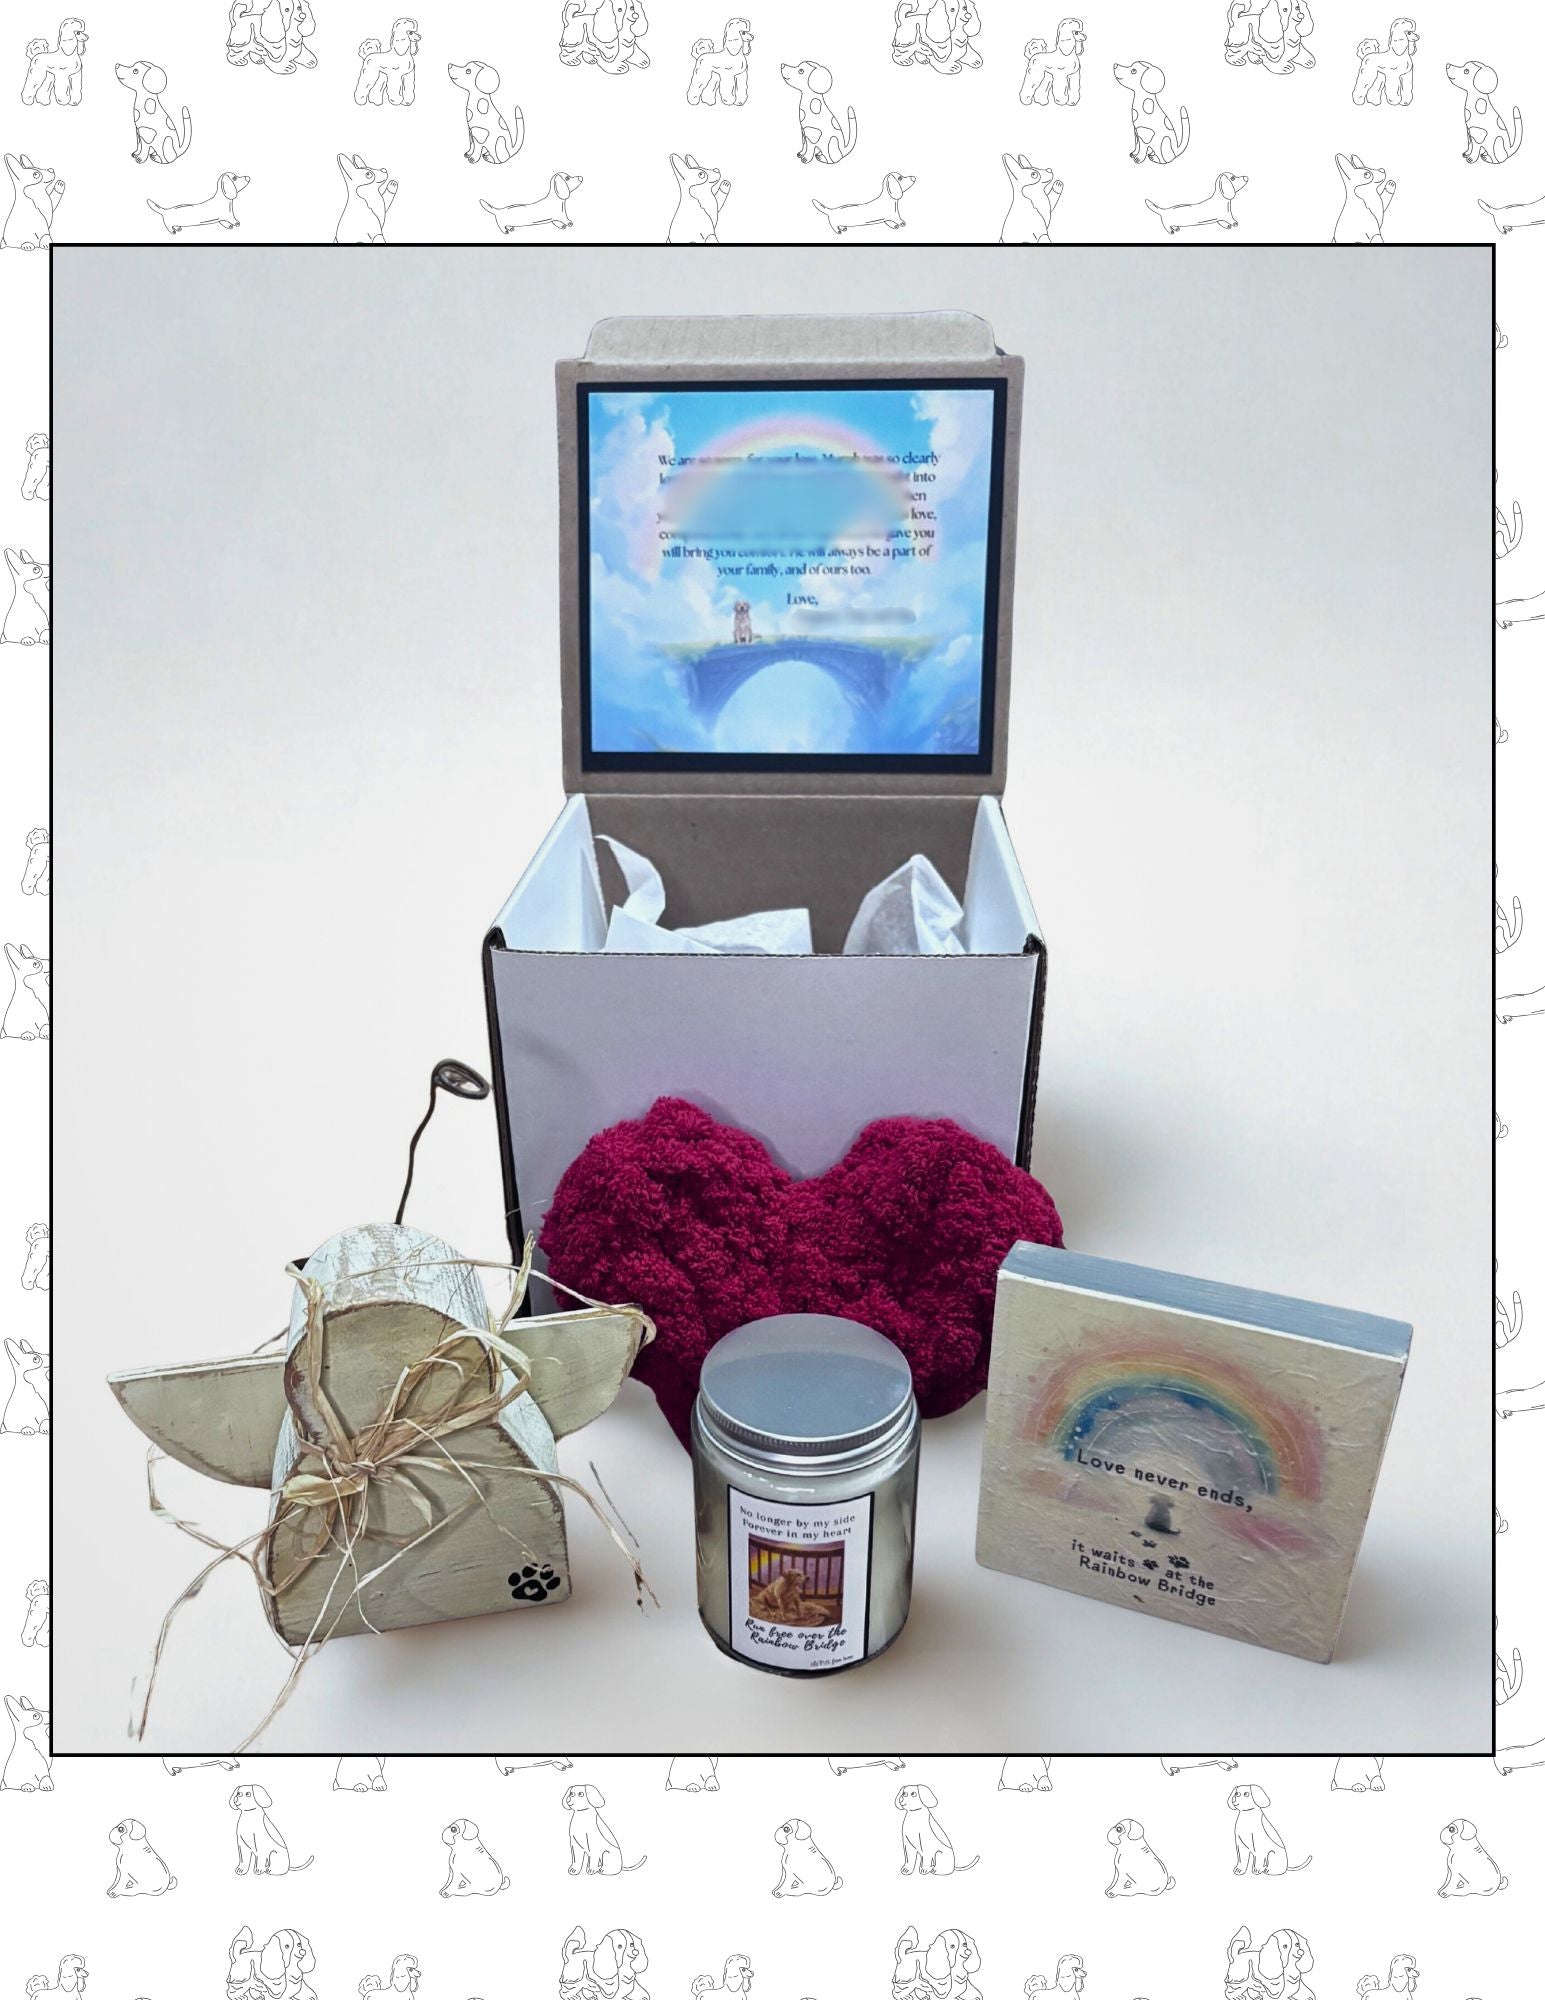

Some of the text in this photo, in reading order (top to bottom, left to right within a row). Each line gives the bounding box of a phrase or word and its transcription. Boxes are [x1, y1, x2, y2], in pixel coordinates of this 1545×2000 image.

[658, 454, 676, 466] We
[902, 451, 940, 466] clearly
[913, 471, 936, 483] into
[911, 508, 937, 520] love,
[913, 529, 935, 541] you
[662, 546, 681, 558] will
[682, 546, 714, 561] bring
[714, 548, 736, 560] you
[866, 545, 880, 557] be
[882, 549, 890, 557] a
[892, 546, 916, 560] part
[918, 544, 934, 557] of
[716, 565, 745, 578] your
[785, 563, 807, 575] and
[808, 563, 823, 575] of
[822, 564, 848, 575] ours
[786, 592, 819, 607] Love,
[1077, 1448, 1253, 1513] Love never ends,
[740, 1505, 856, 1530] No longer by my side
[742, 1518, 852, 1541] Forever in my heart
[1071, 1538, 1215, 1591] it waits at the
[1079, 1554, 1216, 1606] Rainbow Bridge
[744, 1617, 848, 1640] Run free over the
[750, 1630, 847, 1652] Rainbow Bridge
